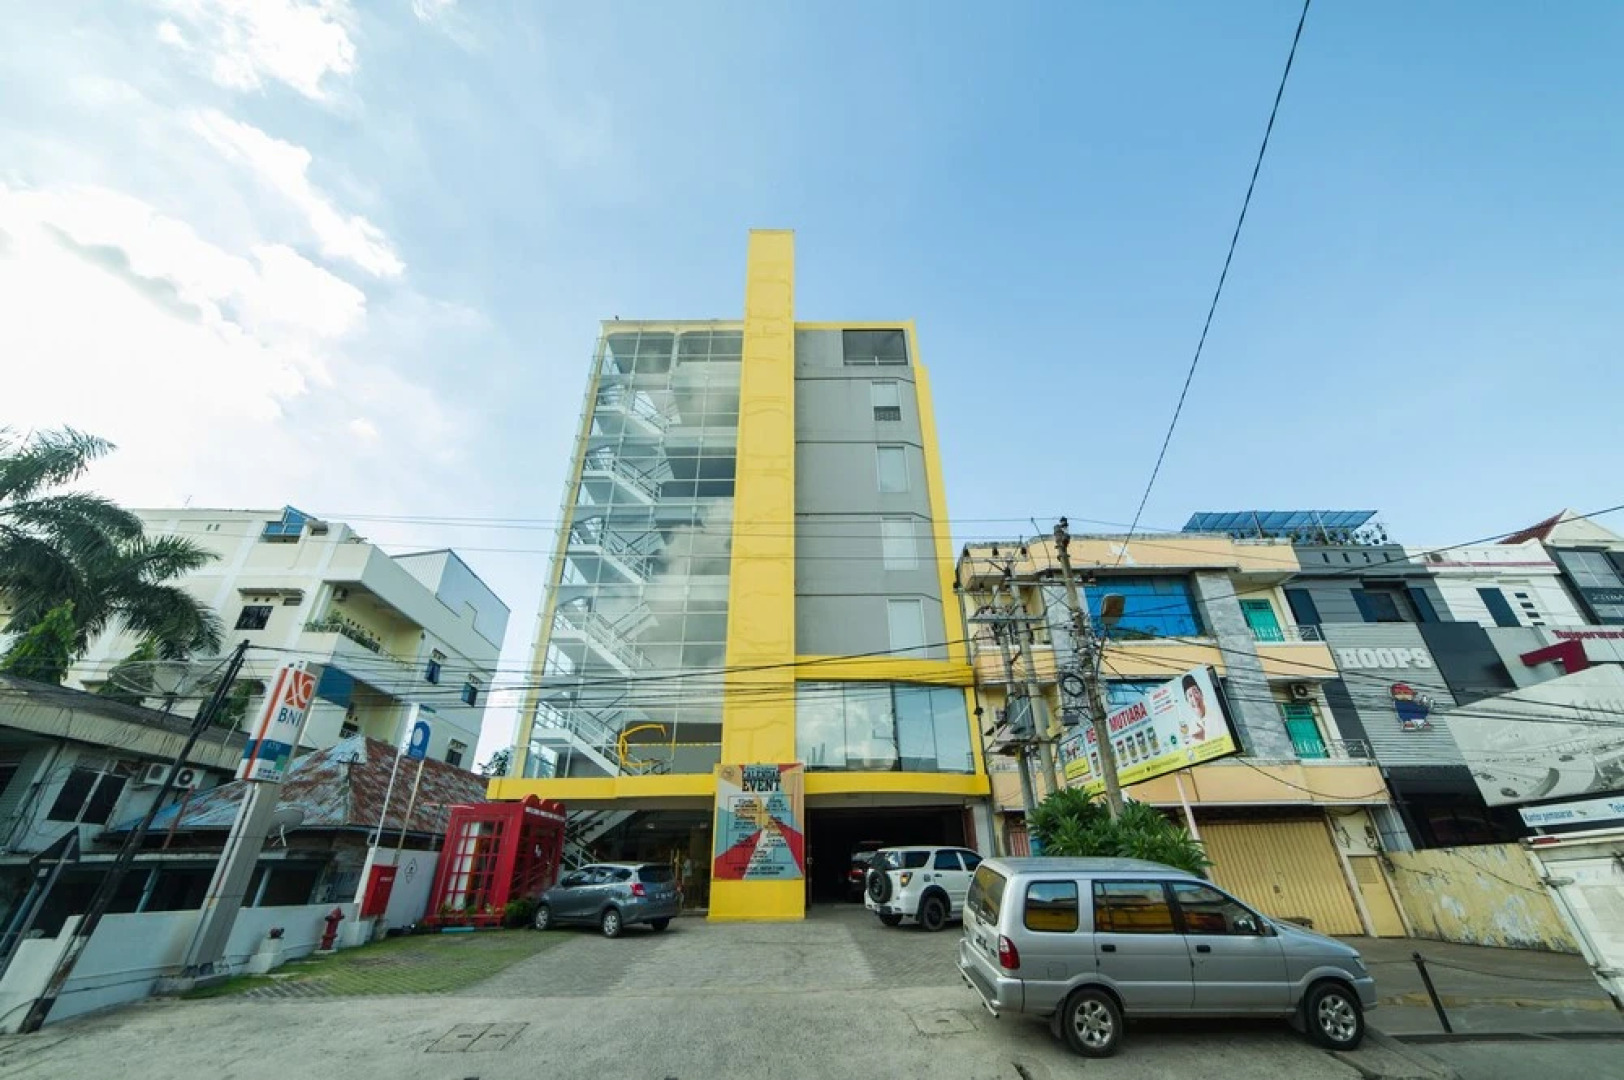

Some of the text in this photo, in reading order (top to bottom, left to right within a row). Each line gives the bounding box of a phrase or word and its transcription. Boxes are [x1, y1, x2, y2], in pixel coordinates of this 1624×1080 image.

[1338, 647, 1432, 669] HOOPS
[278, 707, 303, 728] BNI
[1108, 701, 1148, 732] MUTIARA
[741, 779, 780, 792] EVENT
